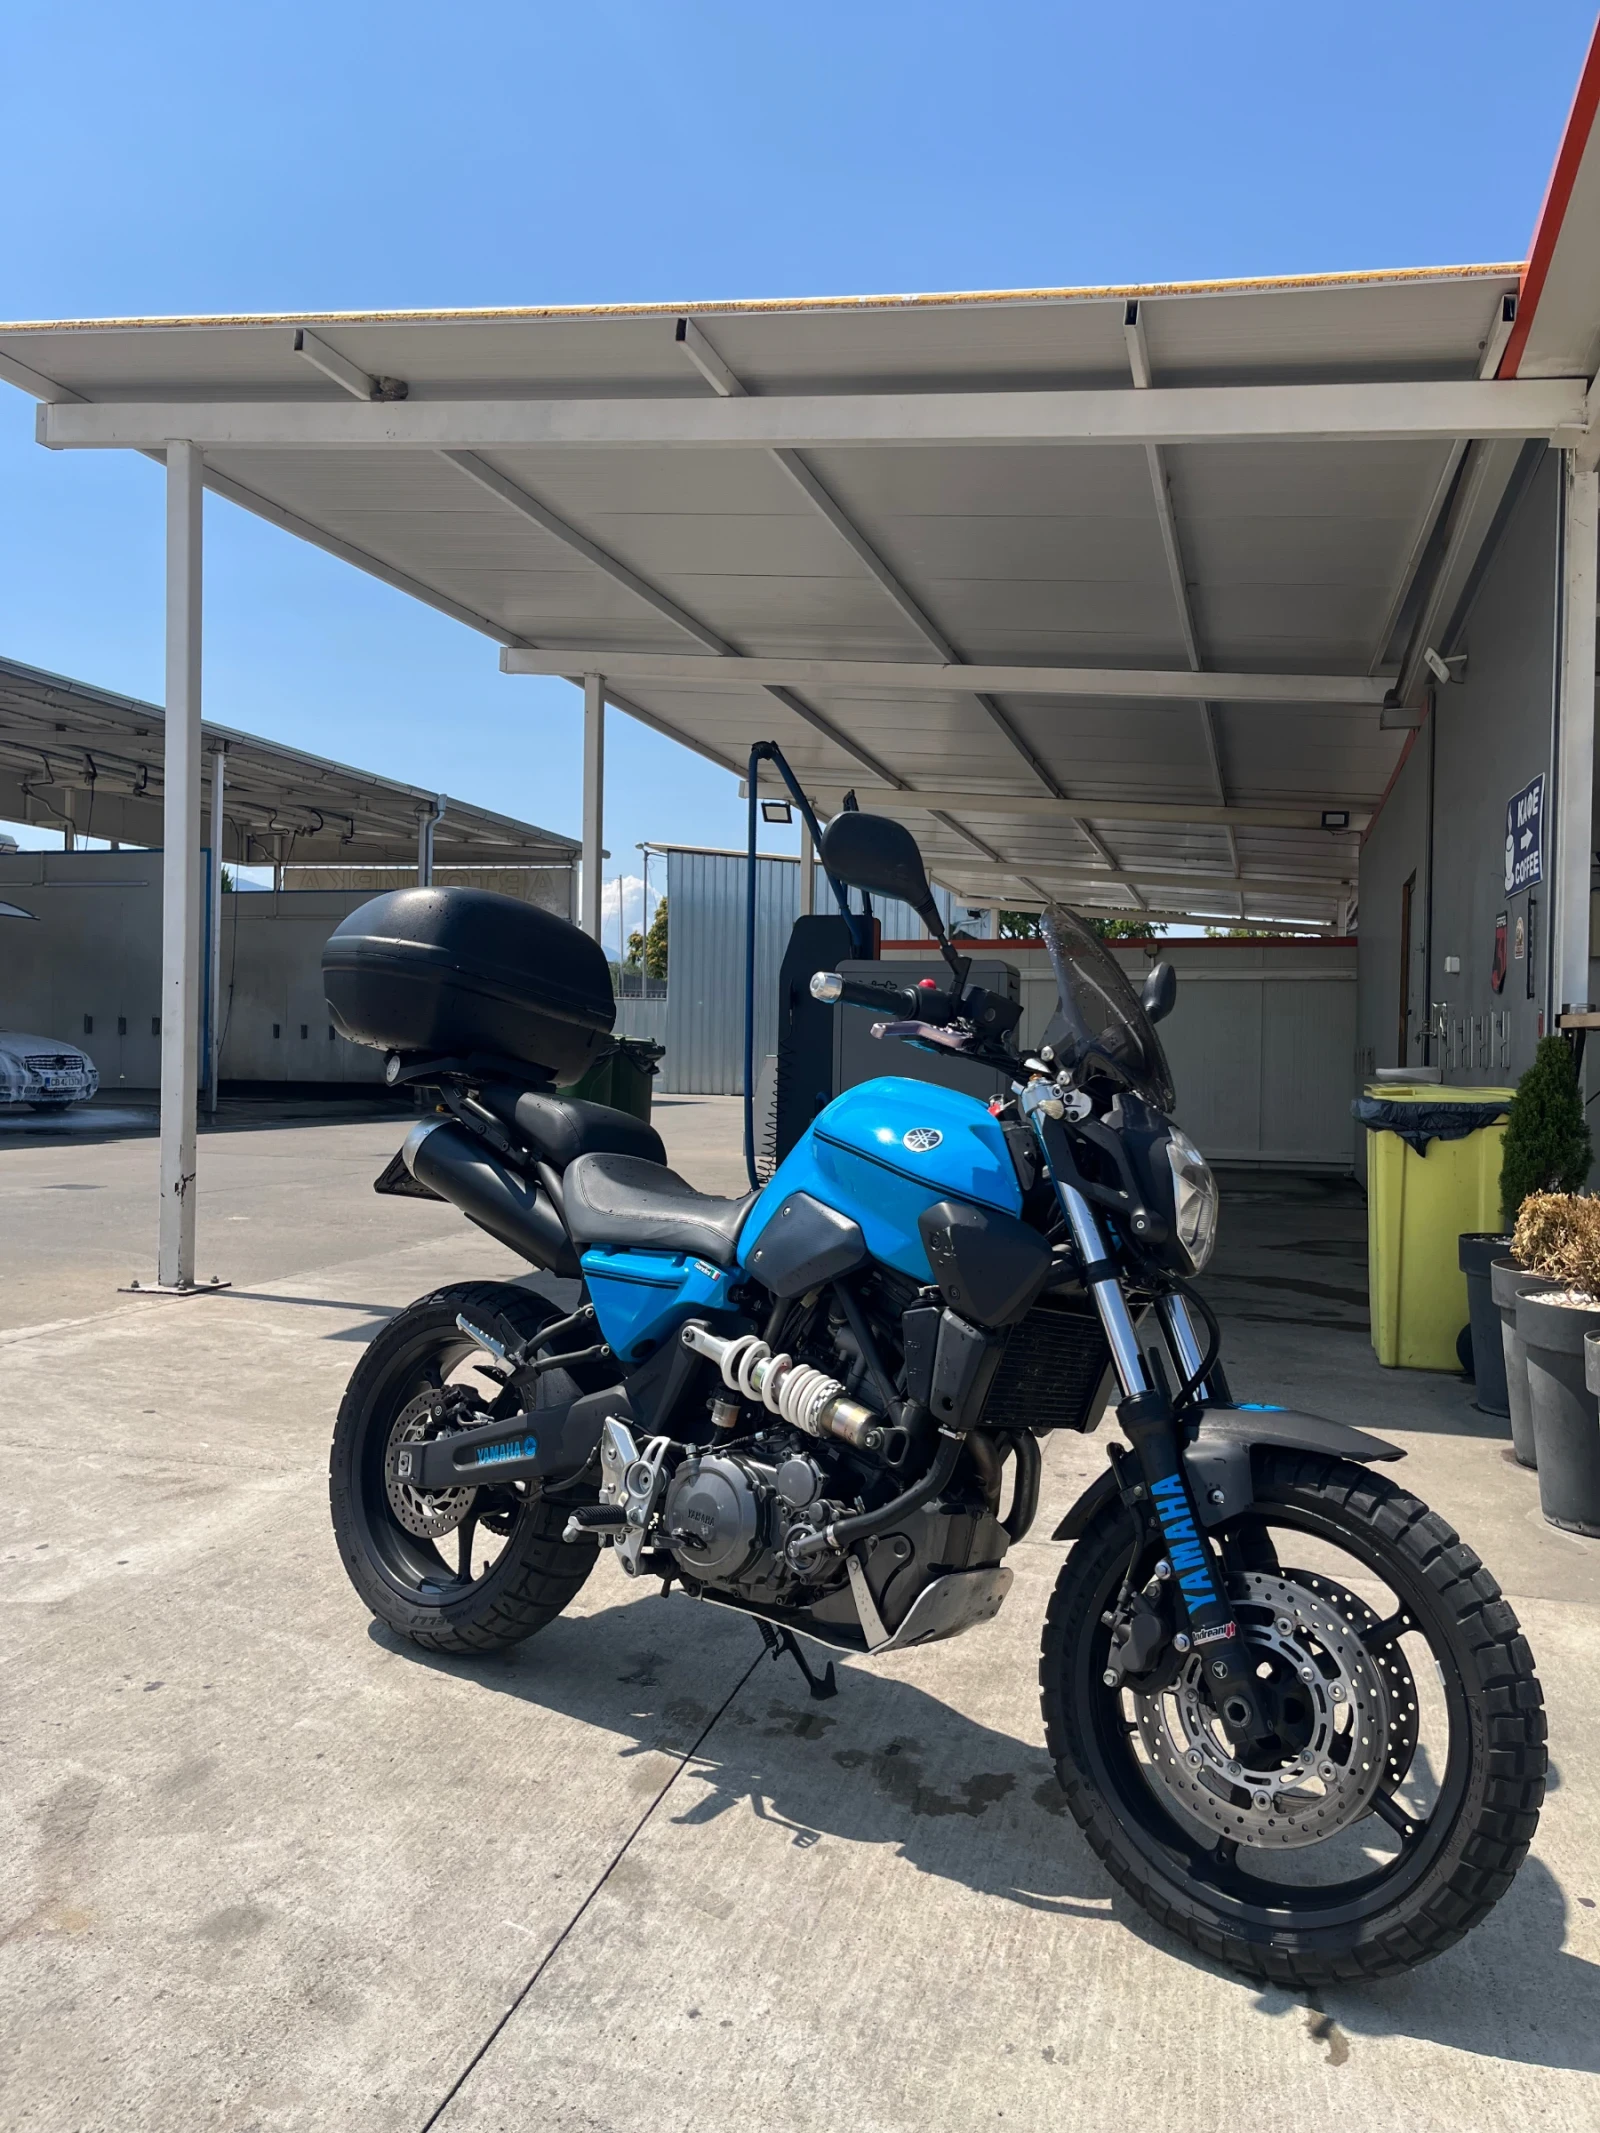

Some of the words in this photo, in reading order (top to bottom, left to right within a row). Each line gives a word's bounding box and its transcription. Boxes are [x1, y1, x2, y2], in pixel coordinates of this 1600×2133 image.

[1517, 786, 1539, 828] КАФЕ
[1515, 850, 1539, 885] COFFEE
[476, 1441, 521, 1465] YAMAHA
[687, 1508, 715, 1527] YAMAHA
[1150, 1473, 1217, 1615] YAMAHA
